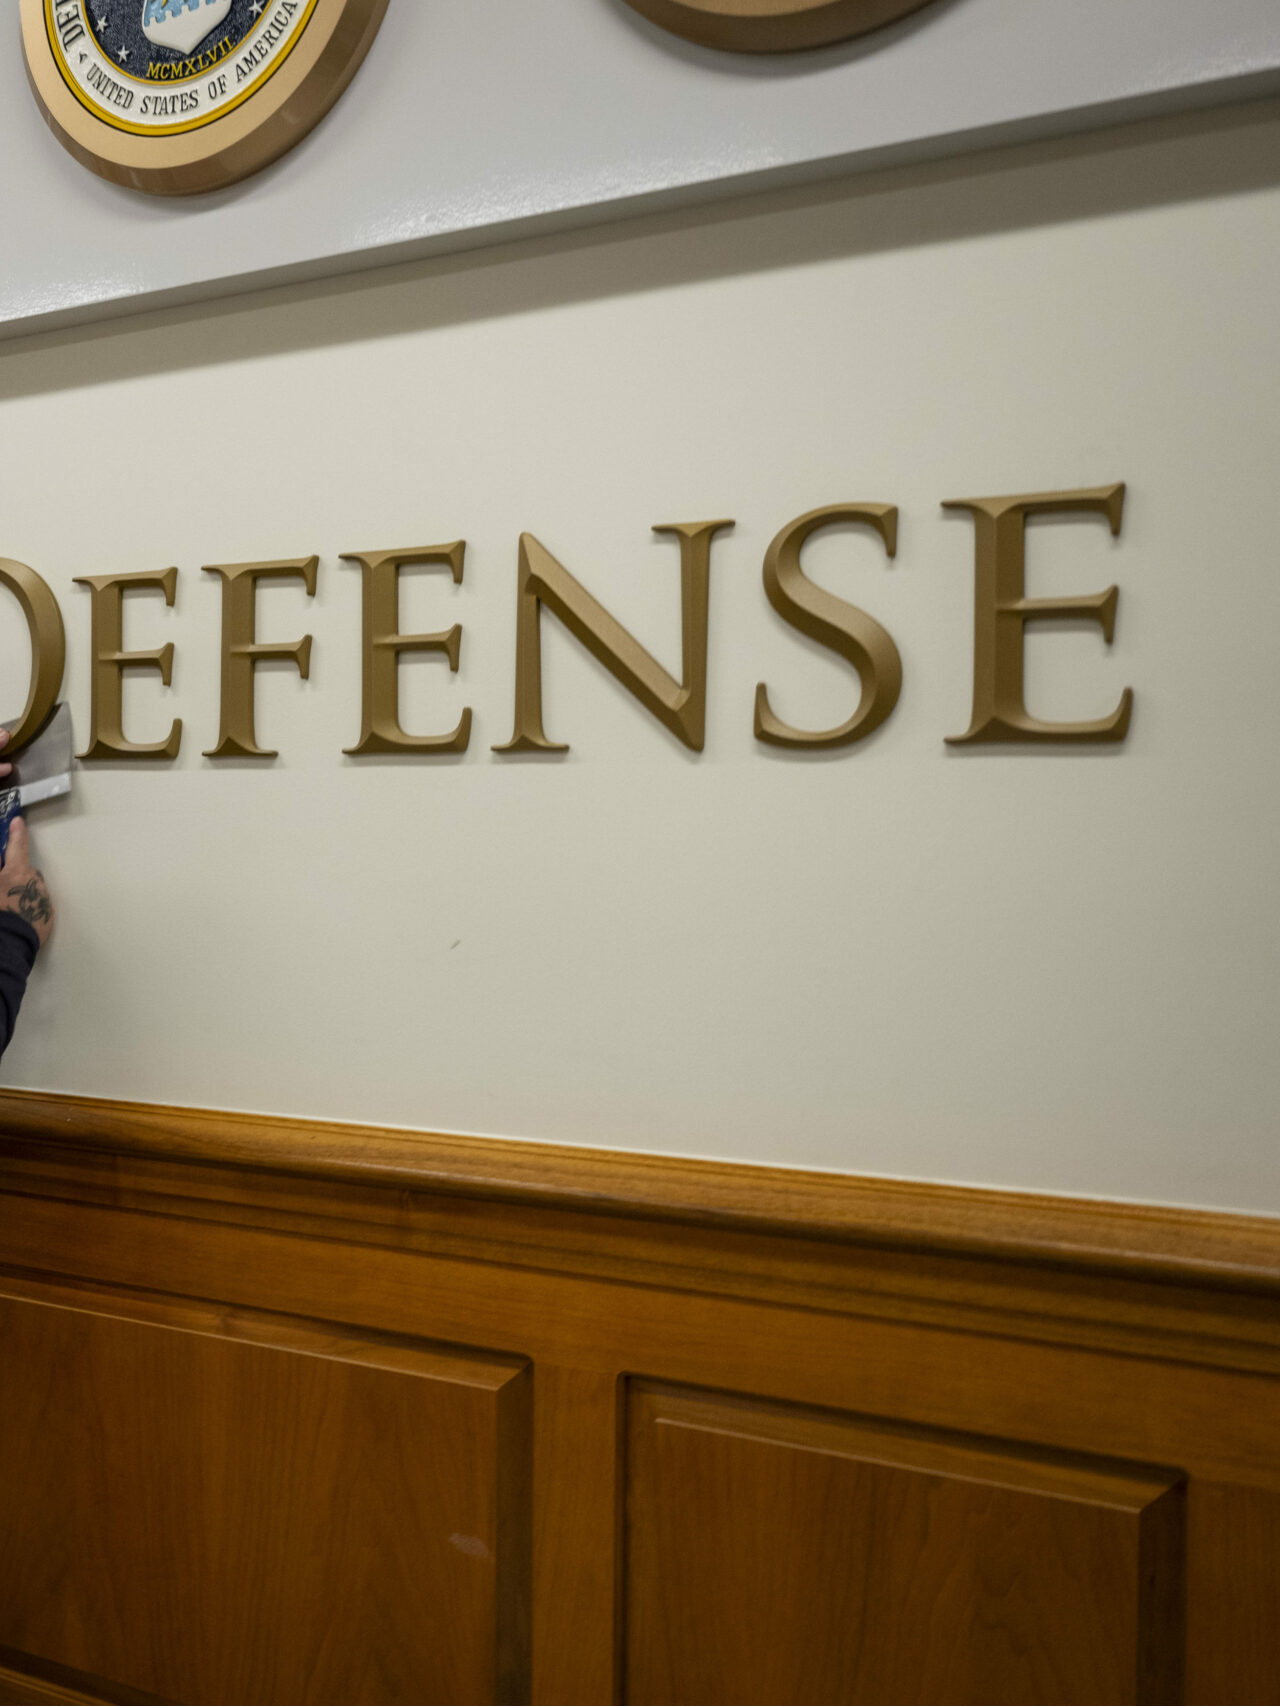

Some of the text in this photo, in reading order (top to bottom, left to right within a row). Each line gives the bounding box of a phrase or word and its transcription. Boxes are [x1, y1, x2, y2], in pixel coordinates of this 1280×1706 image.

[86, 2, 298, 116] UNITED STATES OF AMERICA
[146, 36, 236, 79] MCMXLVII
